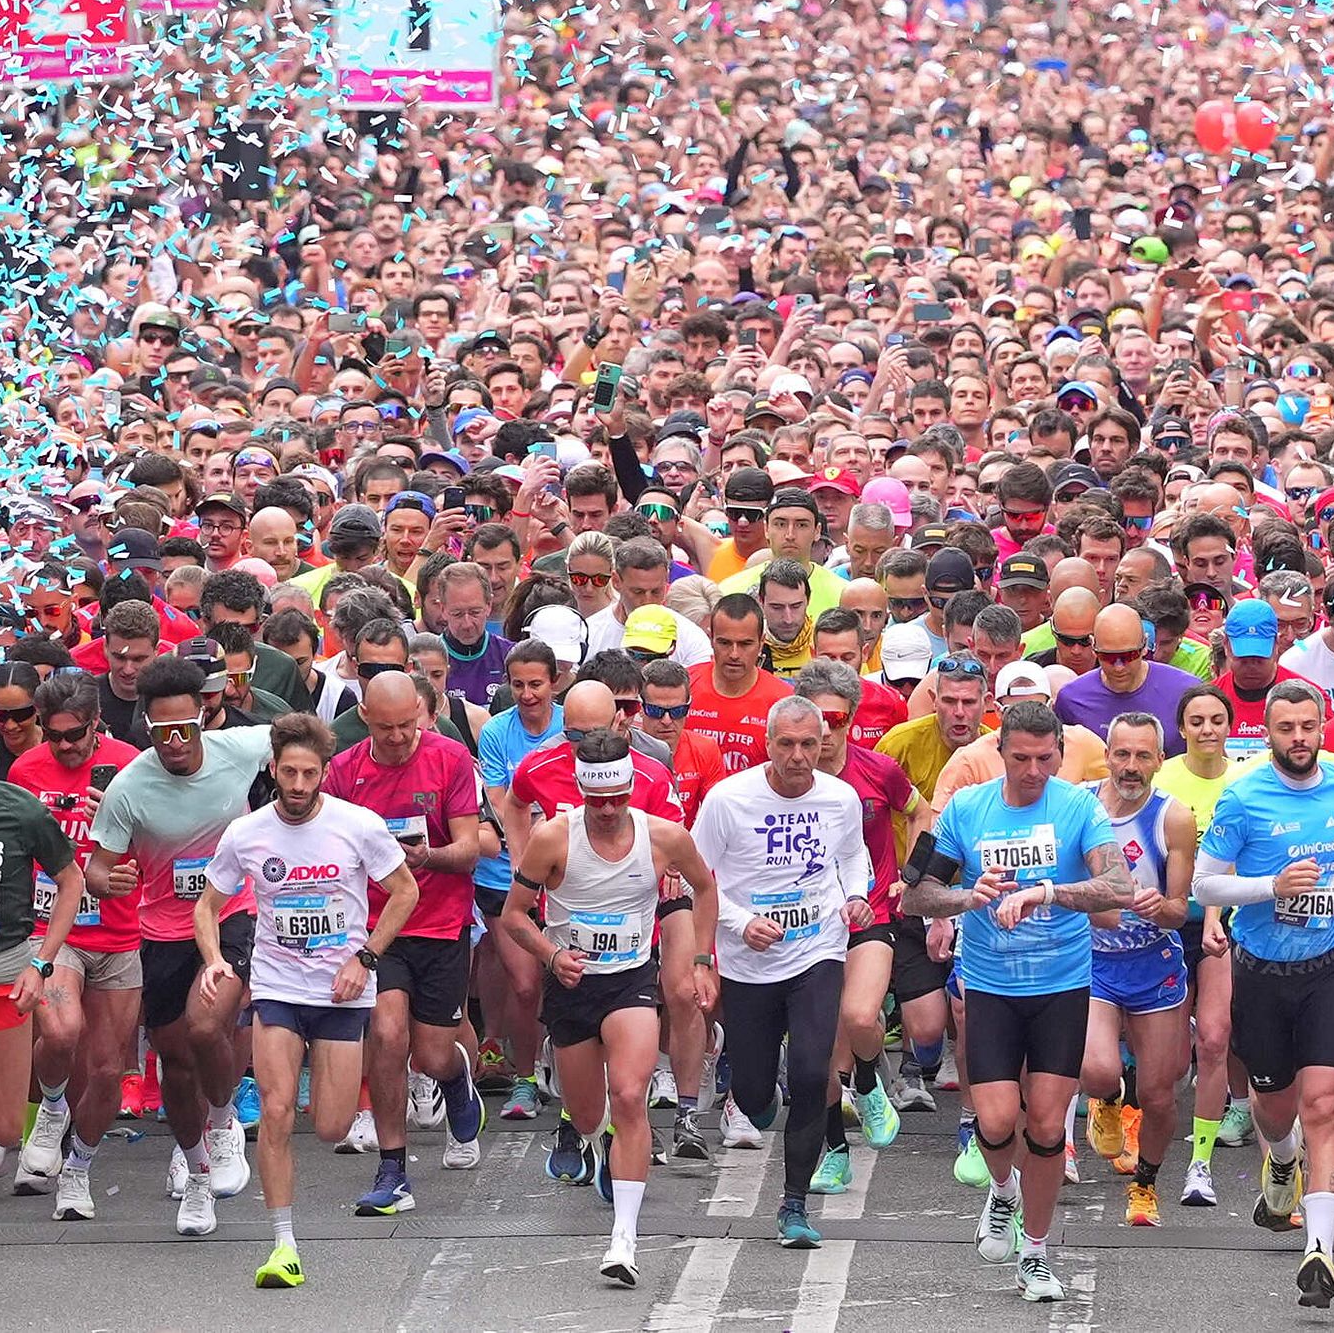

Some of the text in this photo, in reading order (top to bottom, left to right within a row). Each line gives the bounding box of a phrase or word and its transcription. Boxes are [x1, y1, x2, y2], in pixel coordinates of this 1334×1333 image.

[727, 732, 754, 746] STEP
[778, 811, 819, 825] TEAM
[765, 856, 793, 866] RUN
[993, 845, 1043, 868] 1705A
[286, 863, 340, 881] ADMO
[1288, 894, 1334, 916] 2216A
[289, 915, 332, 936] 630A
[592, 932, 618, 952] 19A
